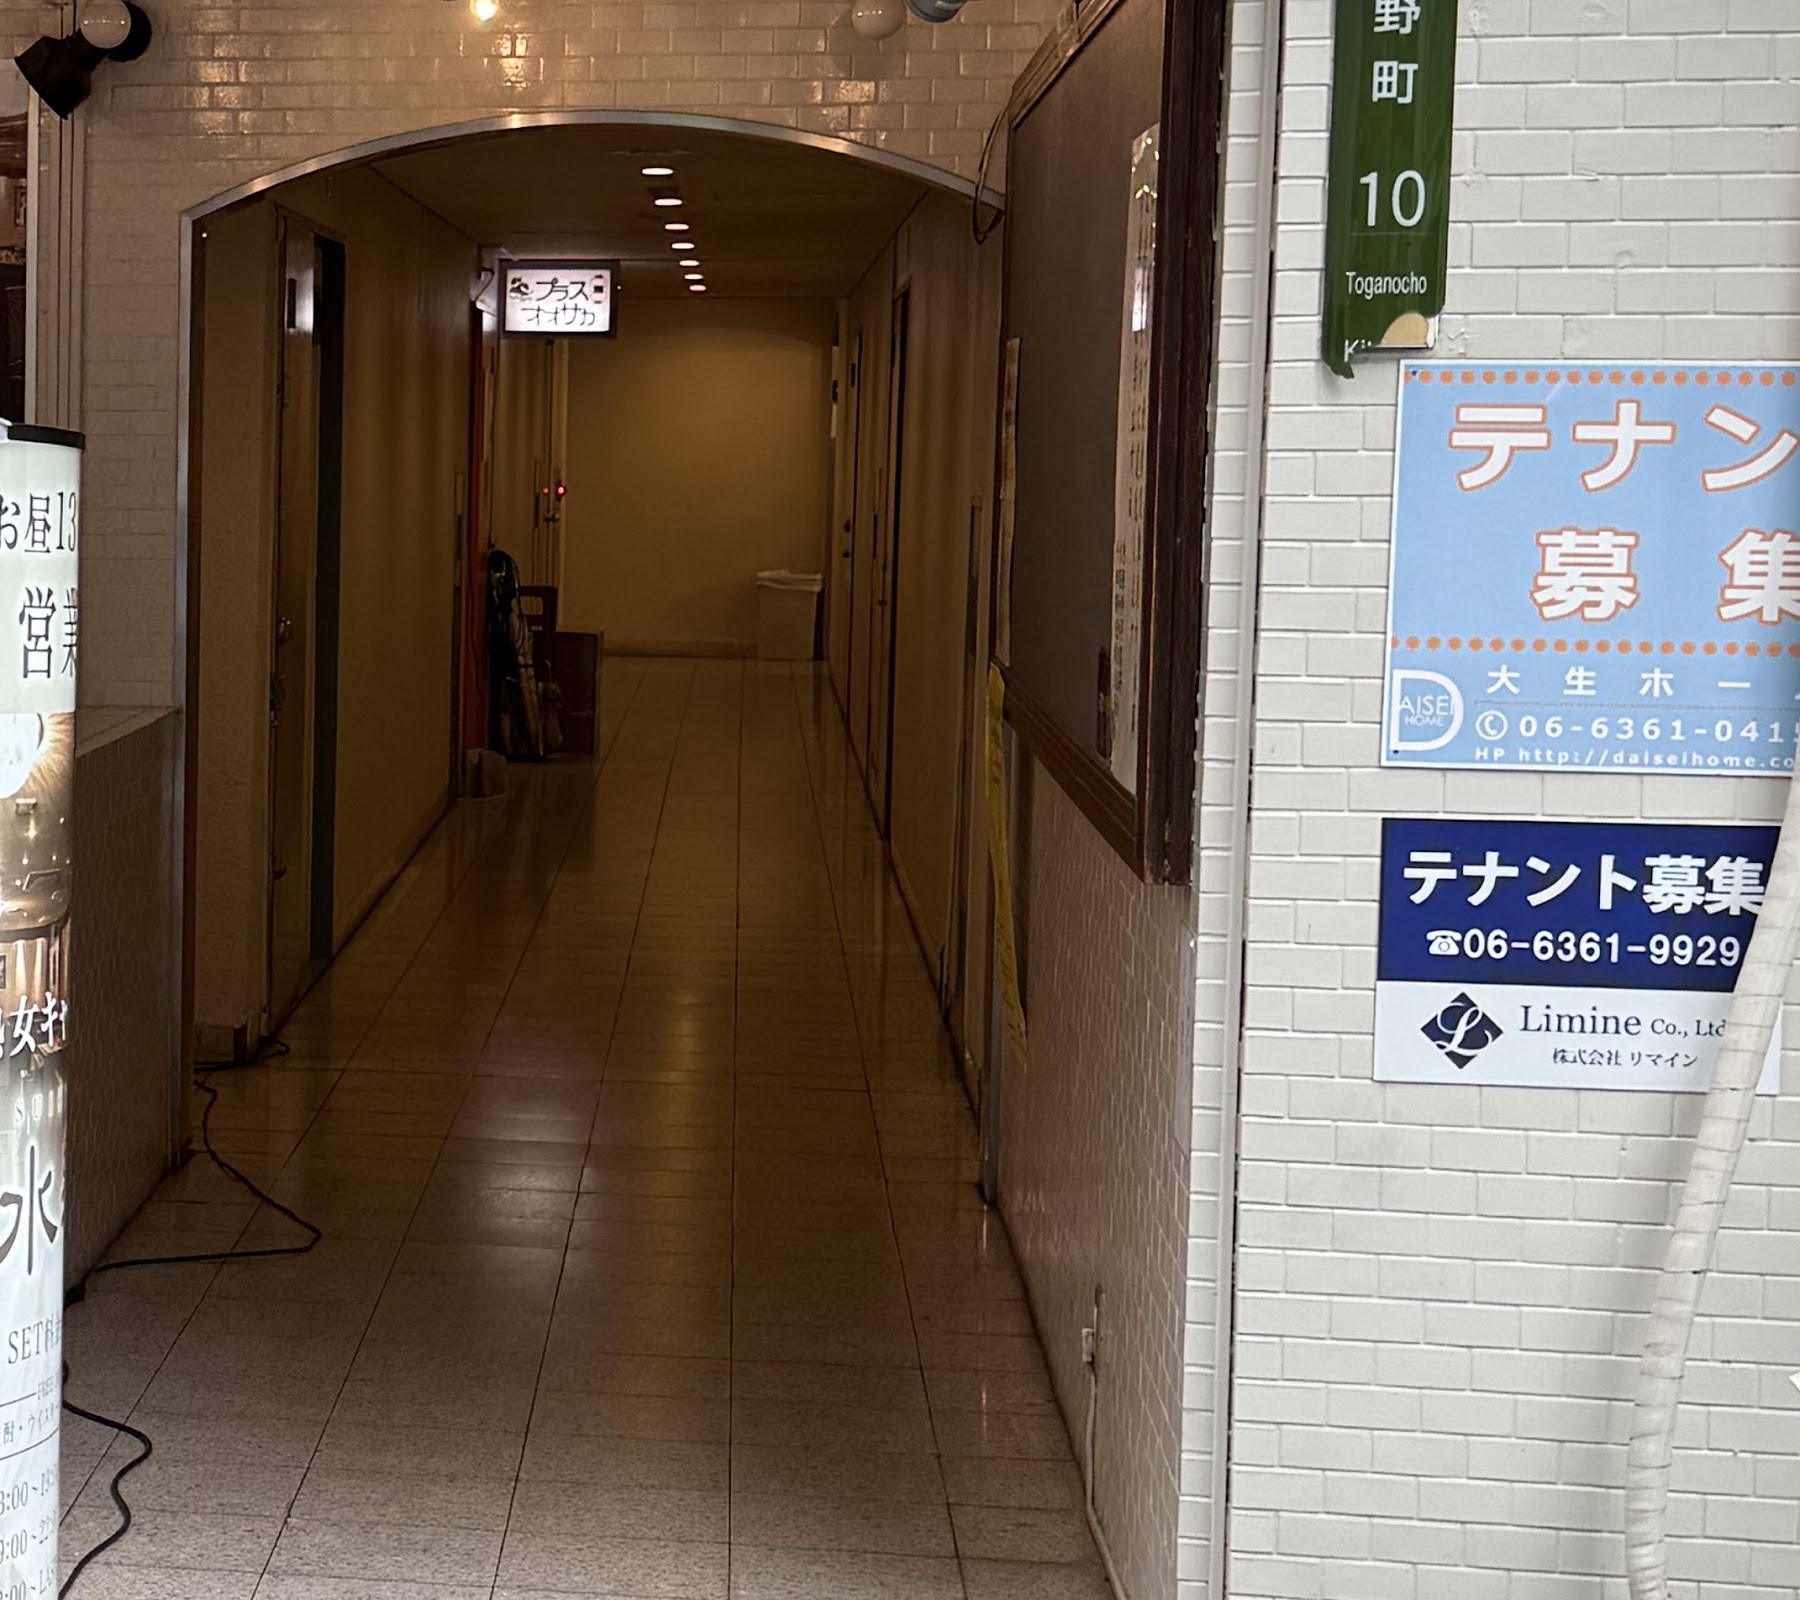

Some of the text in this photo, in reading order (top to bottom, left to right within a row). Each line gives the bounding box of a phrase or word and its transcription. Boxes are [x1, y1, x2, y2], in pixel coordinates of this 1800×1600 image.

[1359, 170, 1425, 227] 10
[536, 277, 590, 301] プラス
[1345, 272, 1427, 300] Toganocho
[1448, 399, 1800, 492] テナン
[1529, 527, 1800, 626] 募集
[1486, 664, 1800, 699] 大生ホー
[1405, 715, 1444, 726] HOME
[1520, 715, 1799, 743] 06-6361-041
[1403, 851, 1764, 916] テナント募集
[1520, 1005, 1641, 1037] Limine
[1631, 1052, 1697, 1068] リマイン
